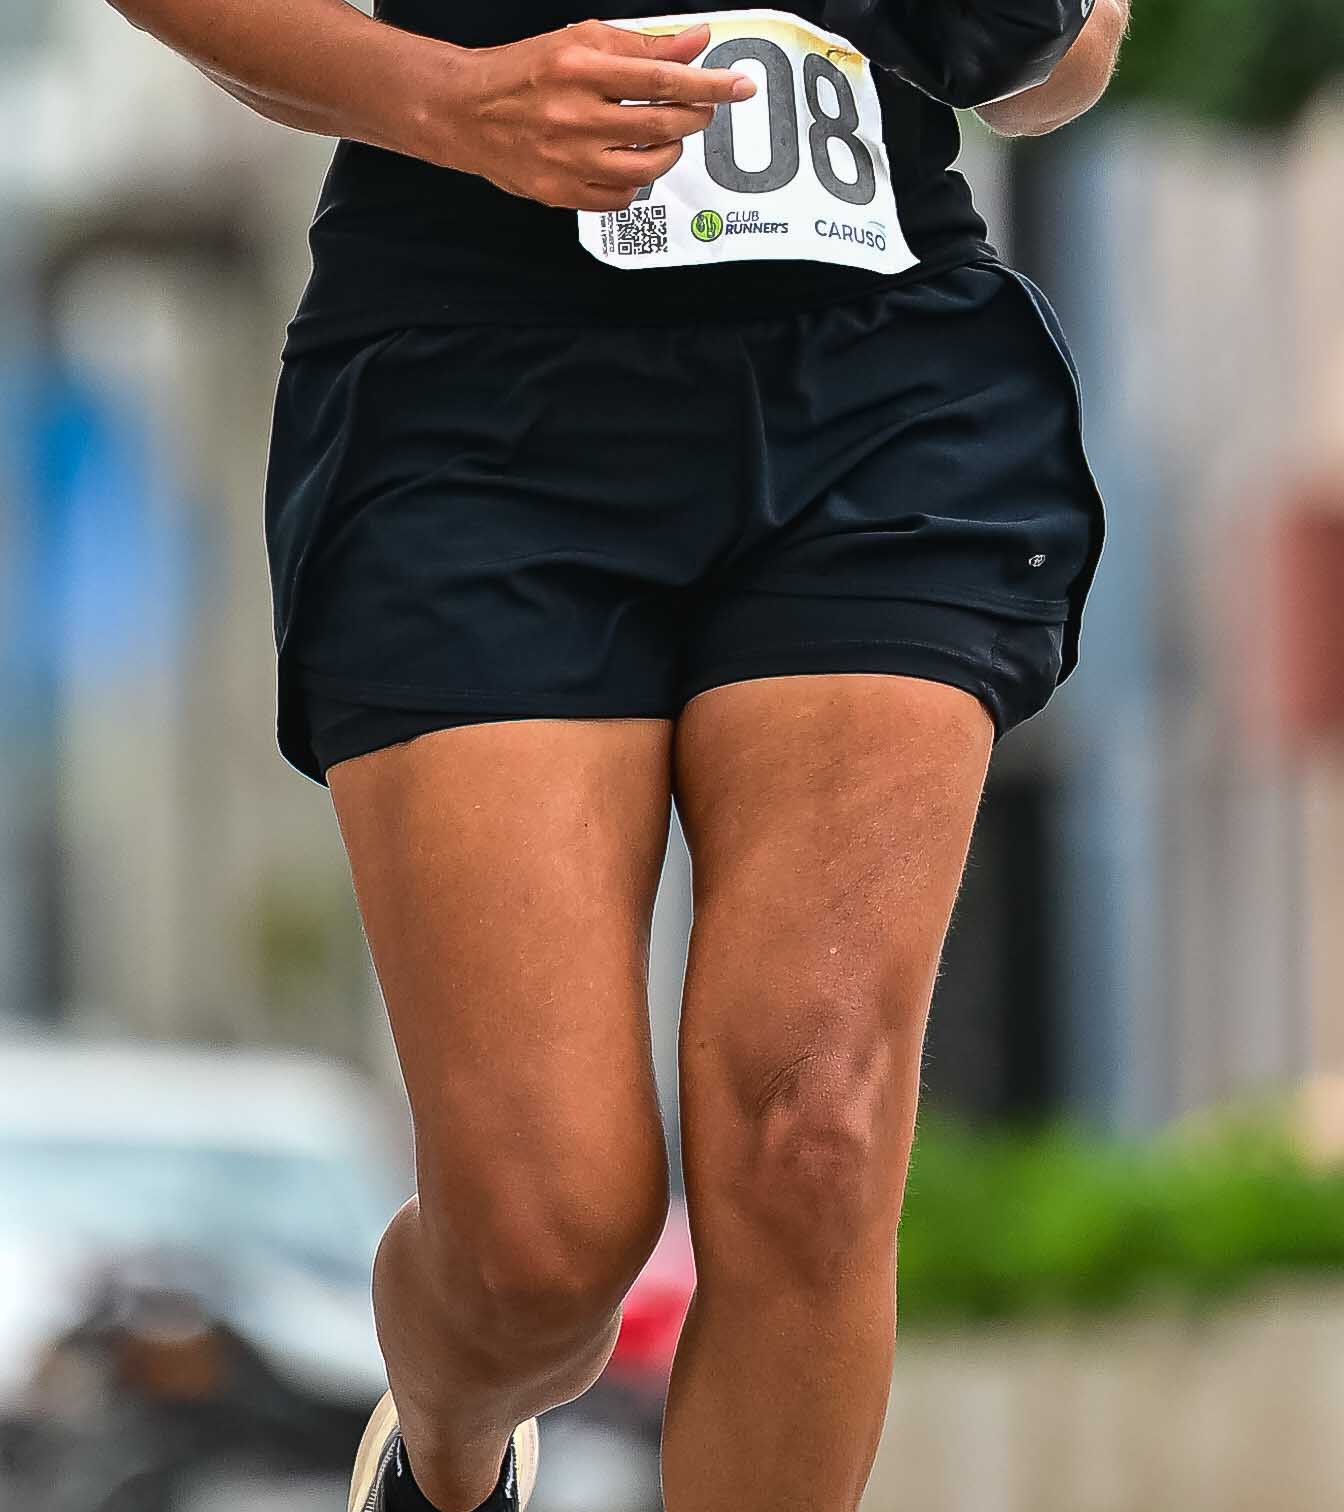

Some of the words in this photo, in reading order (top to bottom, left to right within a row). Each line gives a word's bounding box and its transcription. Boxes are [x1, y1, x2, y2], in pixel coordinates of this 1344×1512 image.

[634, 37, 876, 206] 08
[726, 210, 760, 223] CLUB
[814, 219, 886, 252] CARUSO
